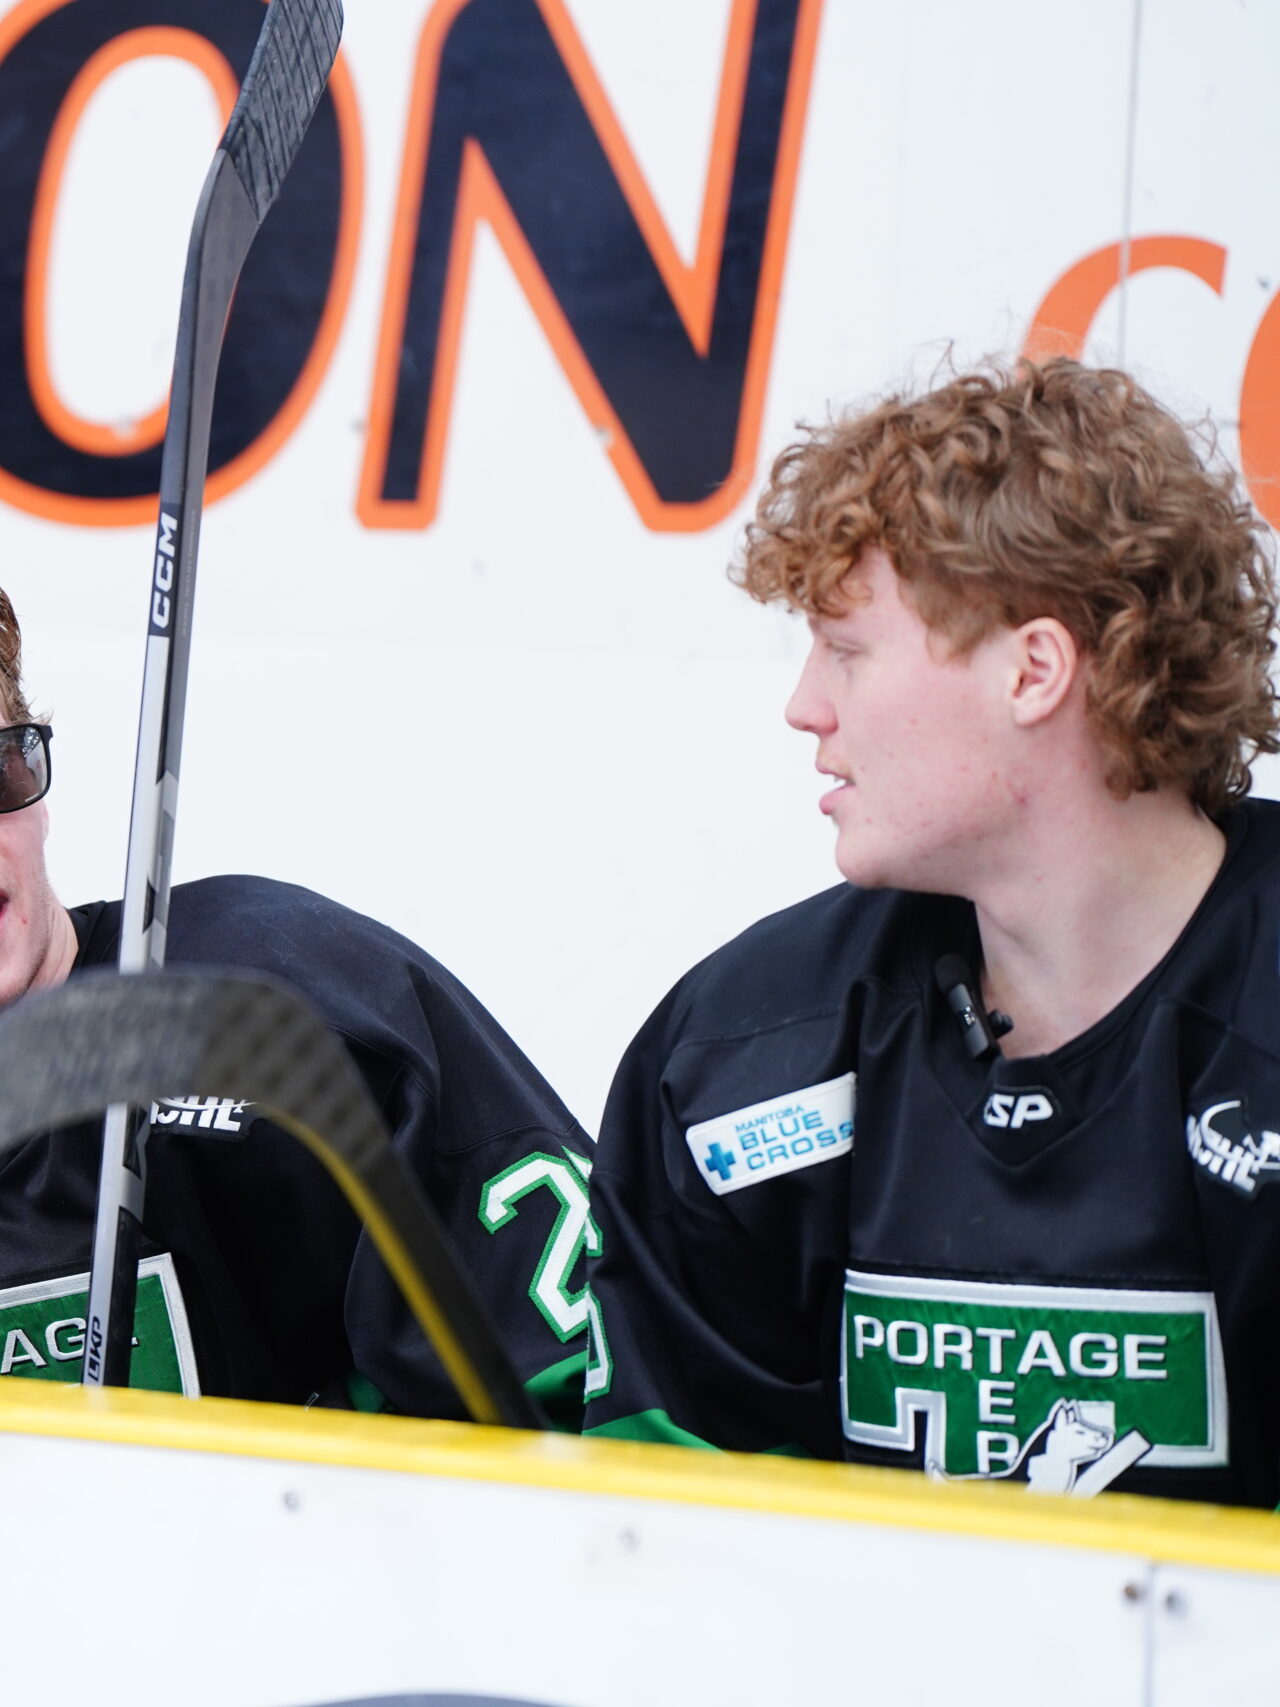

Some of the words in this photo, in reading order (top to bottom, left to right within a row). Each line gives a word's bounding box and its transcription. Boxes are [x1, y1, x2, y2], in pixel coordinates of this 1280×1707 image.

[151, 512, 178, 629] CCM
[734, 1104, 805, 1133] MANITOBA
[738, 1111, 823, 1151] BLUE
[983, 1093, 1054, 1129] SP
[745, 1120, 854, 1171] CROSS
[853, 1314, 1169, 1381] PORTAGE
